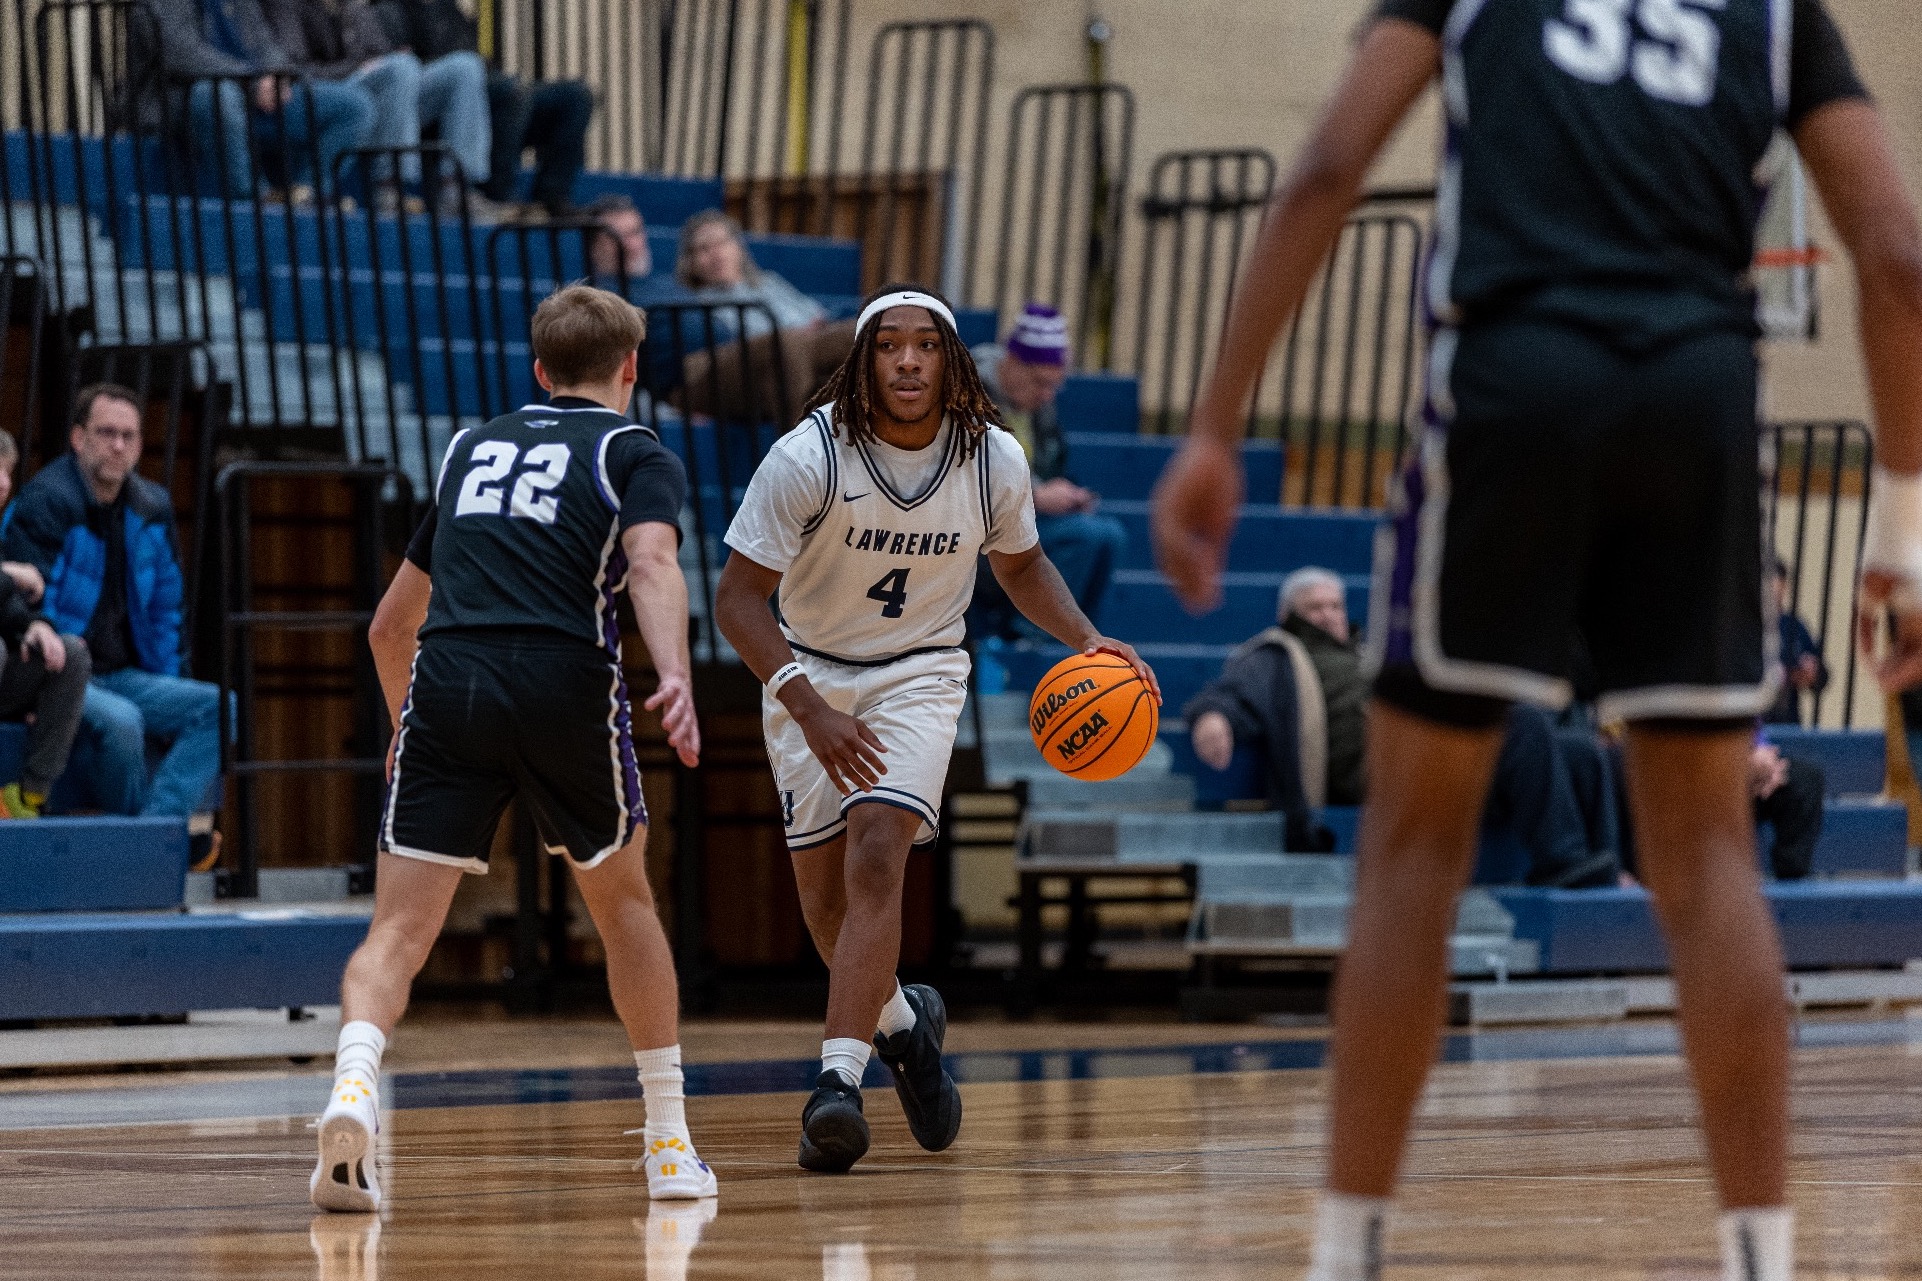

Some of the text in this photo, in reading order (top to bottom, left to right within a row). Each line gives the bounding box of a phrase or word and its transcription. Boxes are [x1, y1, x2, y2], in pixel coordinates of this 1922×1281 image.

[1541, 0, 1727, 107] 35
[455, 439, 572, 525] 22
[844, 525, 961, 556] LAWRENCE
[866, 567, 912, 619] 4
[1031, 678, 1098, 736] Wilson
[1056, 711, 1110, 761] NCAA
